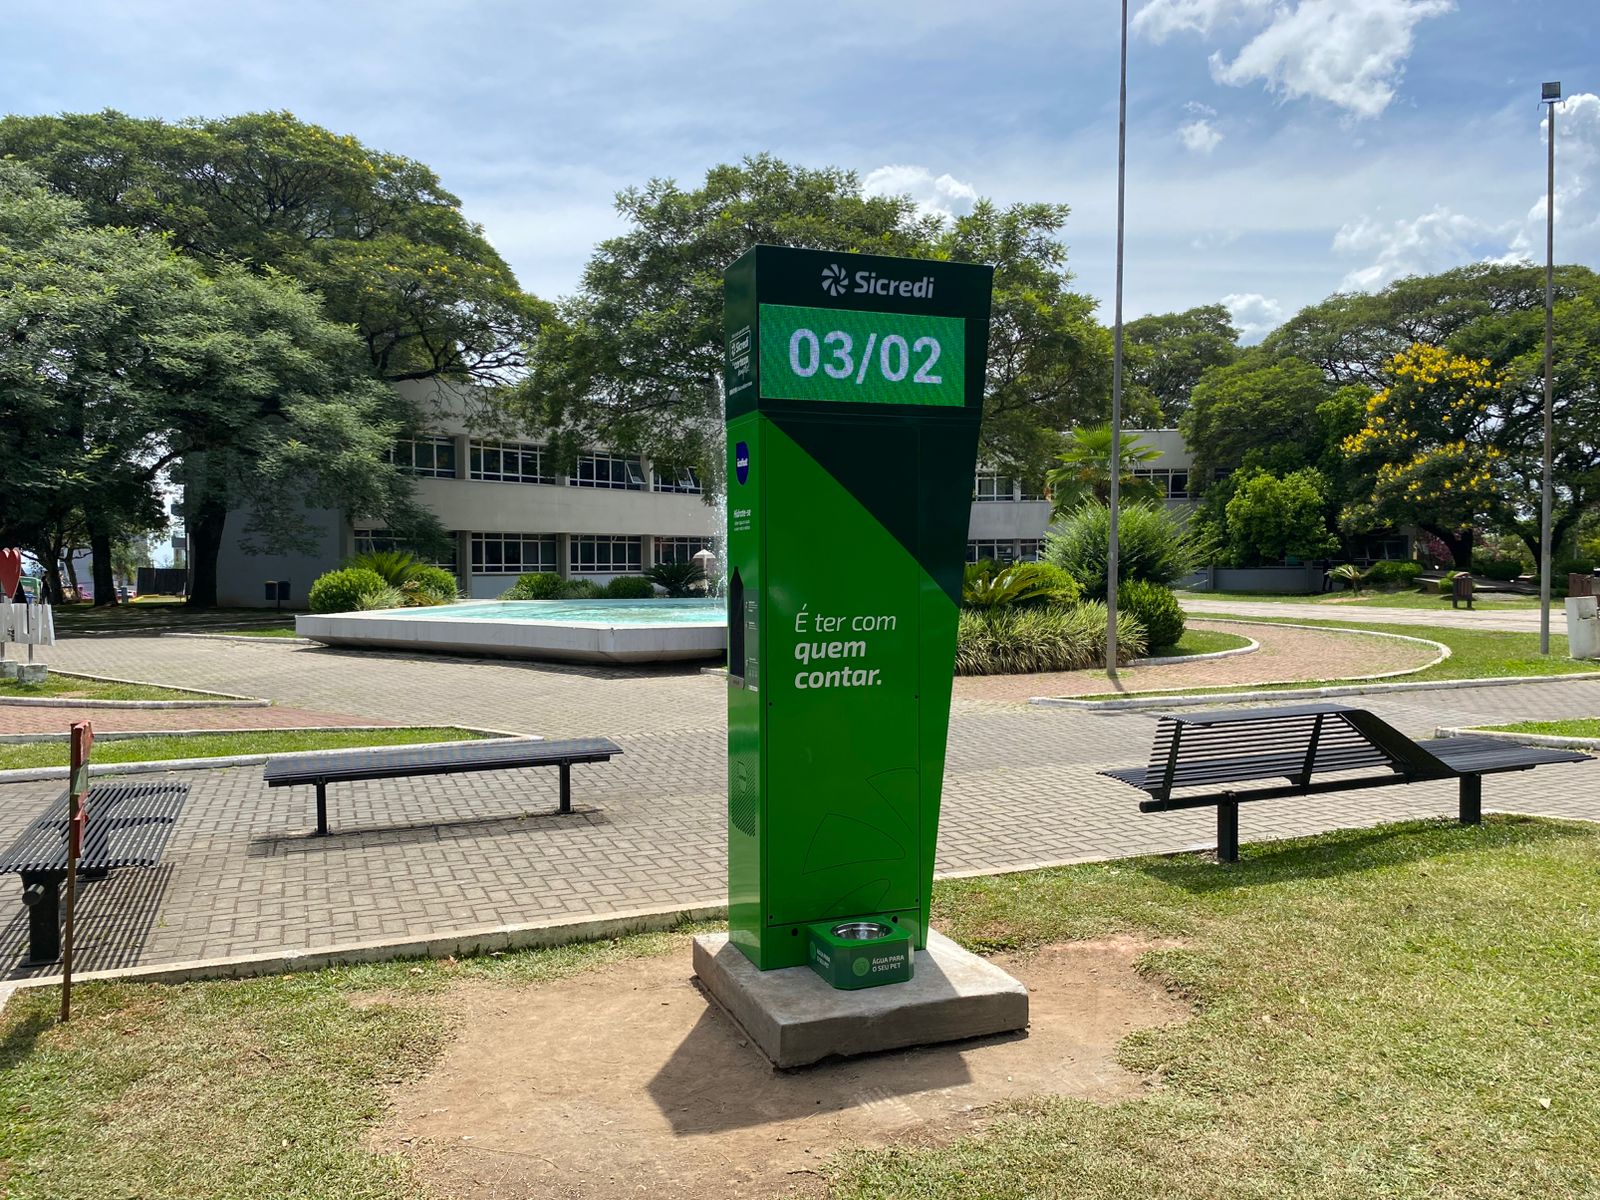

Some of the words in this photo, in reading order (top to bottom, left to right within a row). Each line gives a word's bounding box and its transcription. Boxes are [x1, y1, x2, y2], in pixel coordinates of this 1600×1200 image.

[854, 271, 935, 298] Sicredi
[789, 328, 943, 385] 03/02
[795, 603, 809, 633] É
[815, 613, 847, 632] ter
[852, 615, 897, 631] com
[794, 640, 867, 665] quem
[794, 666, 882, 689] contar.
[878, 964, 889, 972] SEU
[889, 962, 901, 970] PET
[889, 954, 905, 963] PARA
